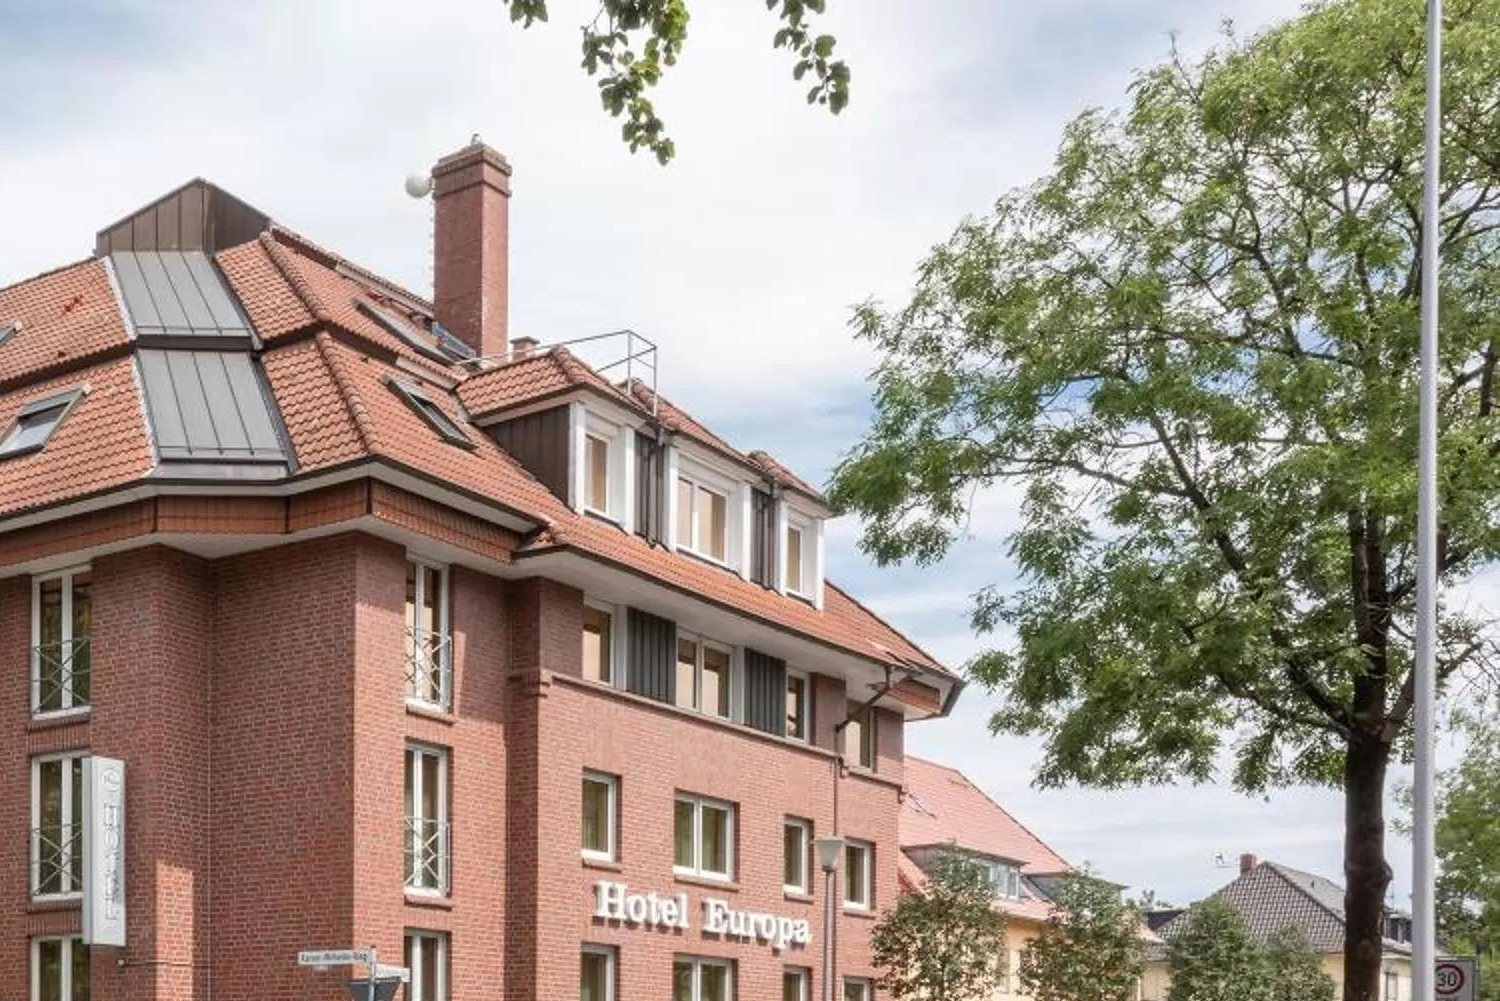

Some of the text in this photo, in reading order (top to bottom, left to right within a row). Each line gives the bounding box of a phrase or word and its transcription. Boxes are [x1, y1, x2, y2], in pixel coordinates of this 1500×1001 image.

[593, 880, 812, 949] Hotel Europa
[1436, 972, 1457, 987] 30
